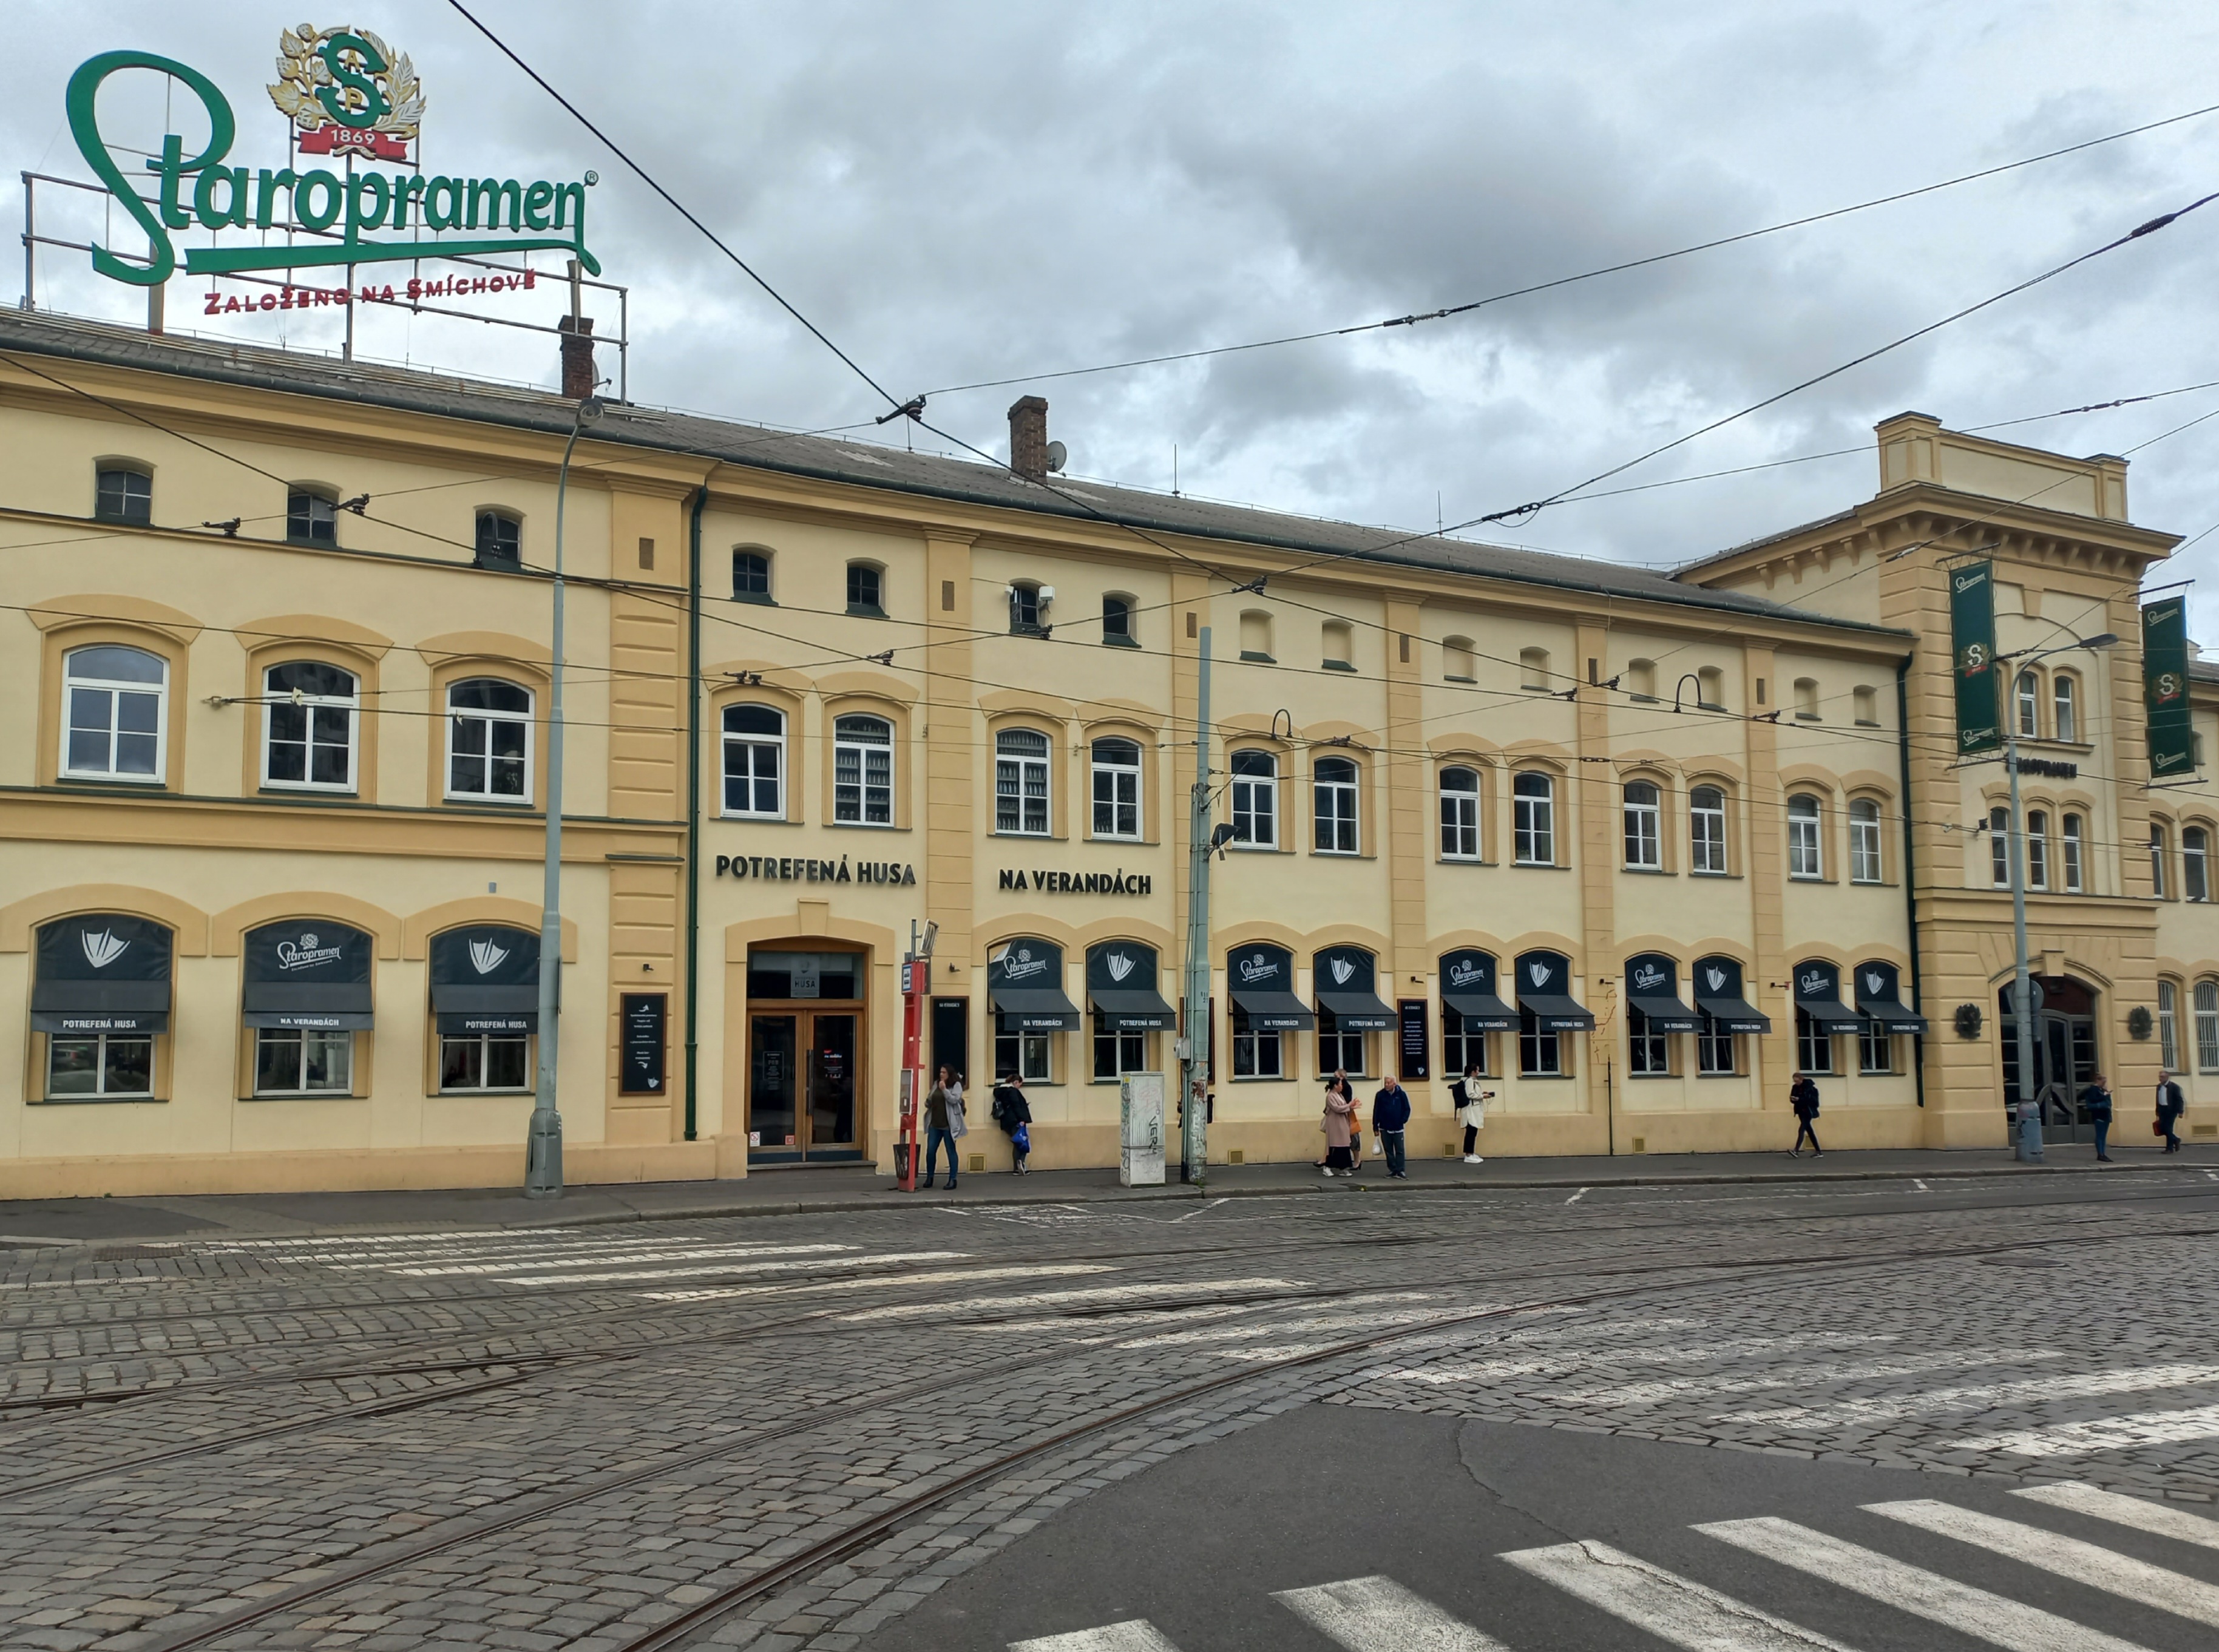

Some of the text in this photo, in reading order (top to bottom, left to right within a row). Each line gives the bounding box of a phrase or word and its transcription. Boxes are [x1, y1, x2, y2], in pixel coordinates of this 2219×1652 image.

[315, 32, 391, 129] S
[331, 129, 375, 144] 1869
[66, 49, 601, 286] Staropramen
[361, 284, 395, 303] NA
[716, 854, 916, 884] POTREFENÁ HUSA
[999, 868, 1151, 894] NA VERANDÁCH
[277, 941, 341, 969] Staropramen
[1003, 956, 1048, 978] Staropramen
[1241, 960, 1278, 981] Staropramen
[63, 1018, 112, 1028] POTREFENÁ
[466, 1020, 506, 1028] POTREFENÁ
